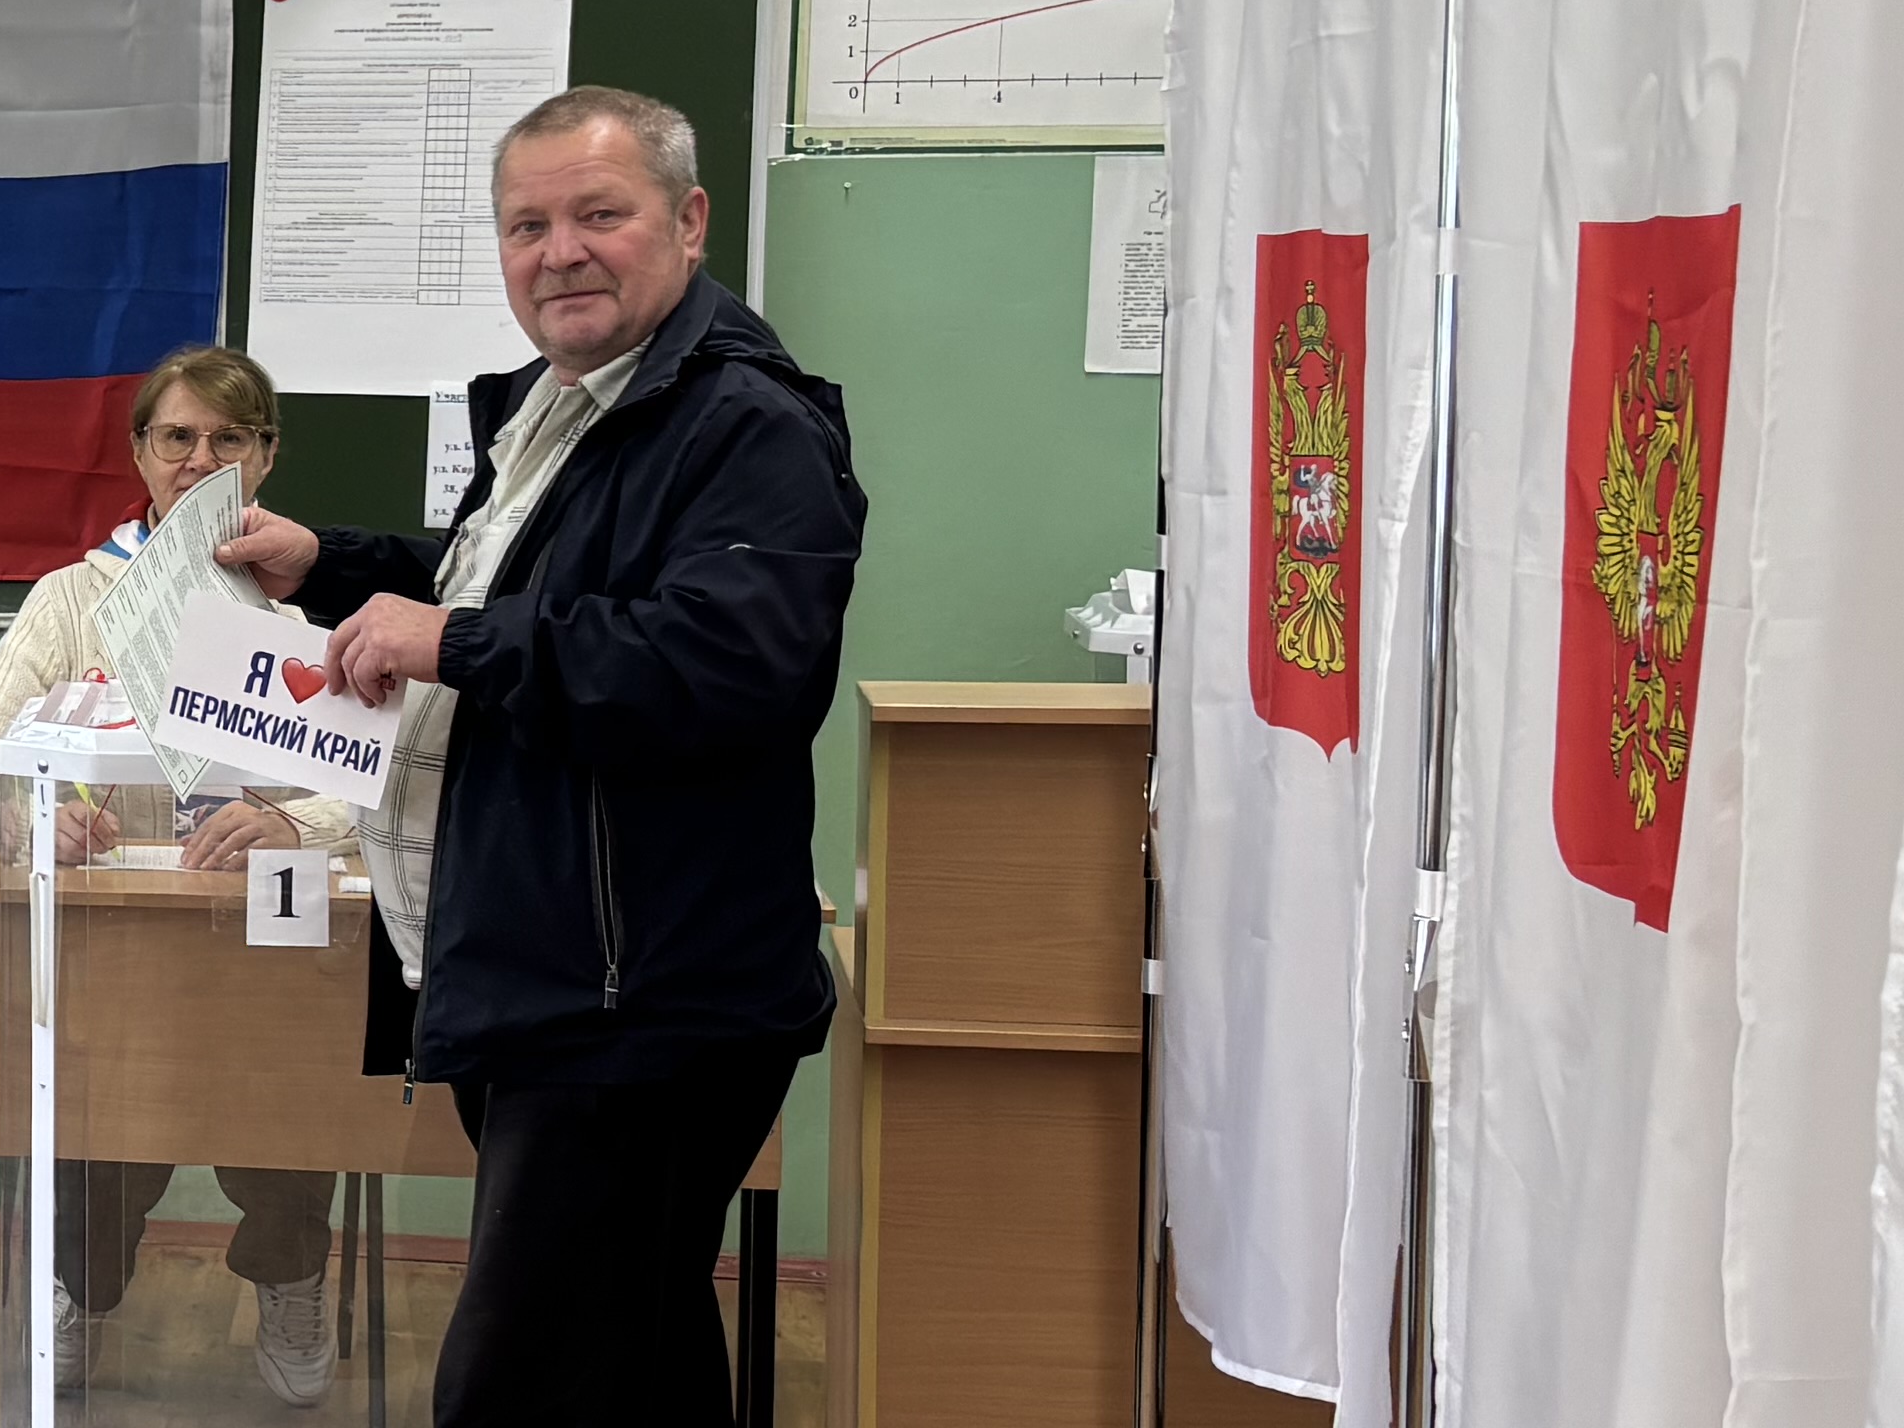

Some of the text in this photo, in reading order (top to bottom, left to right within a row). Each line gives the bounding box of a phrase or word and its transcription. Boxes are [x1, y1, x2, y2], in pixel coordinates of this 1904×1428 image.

[848, 15, 857, 27] 2
[847, 46, 854, 58] 1
[849, 87, 858, 99] 0
[894, 92, 901, 104] 1
[244, 651, 275, 698] Я
[170, 686, 381, 776] ПЕРМСКИЙ КРАЙ
[271, 867, 301, 918] 1
